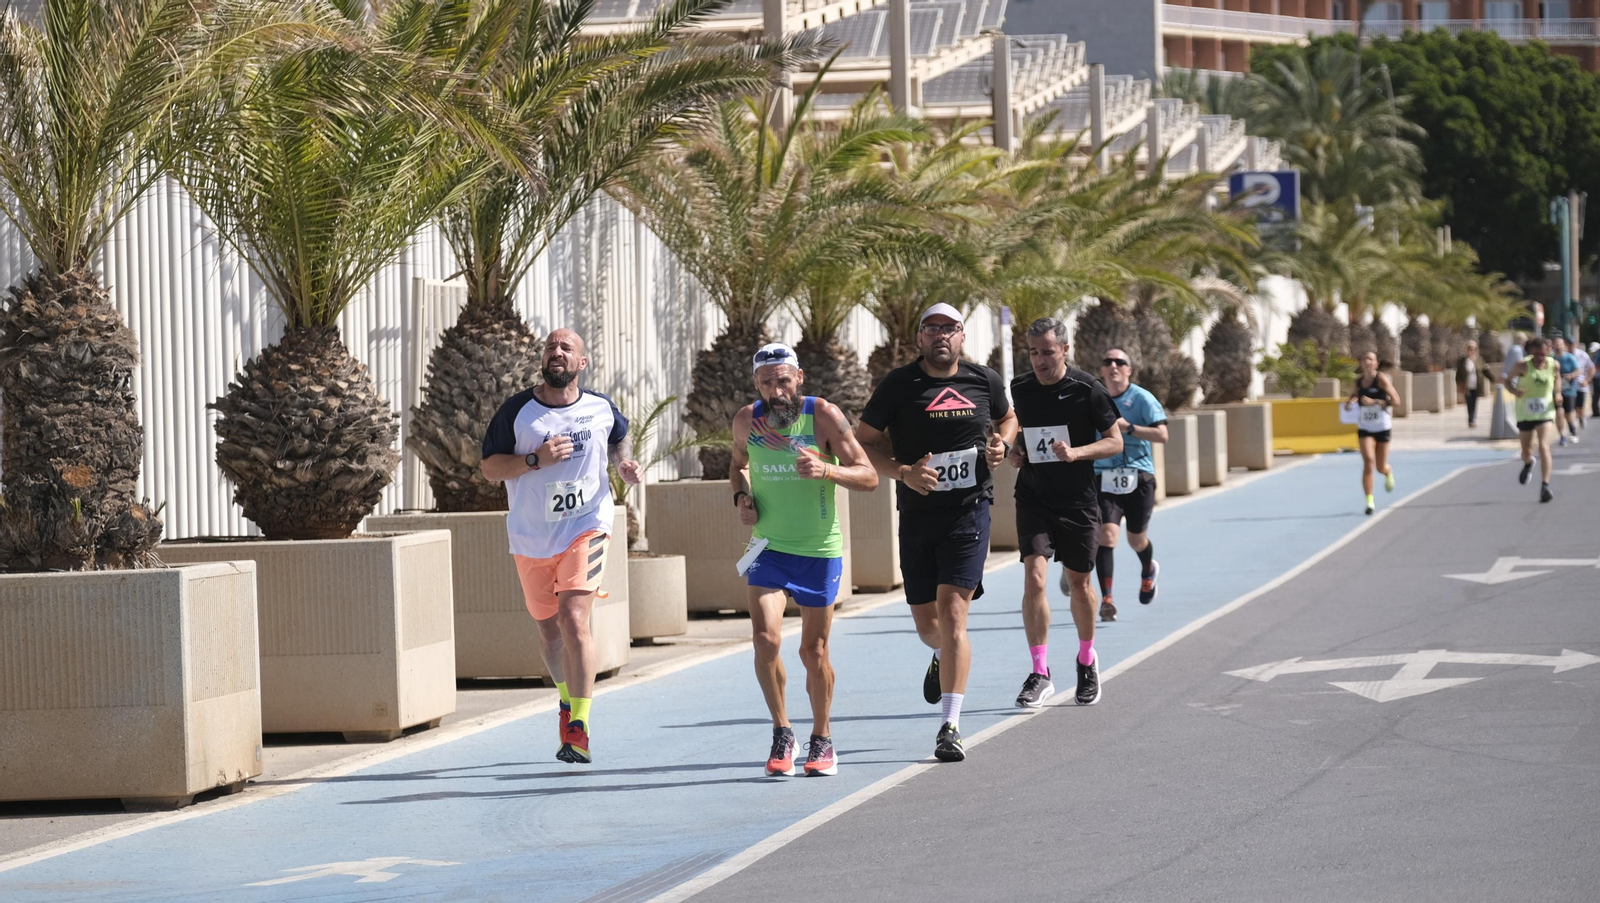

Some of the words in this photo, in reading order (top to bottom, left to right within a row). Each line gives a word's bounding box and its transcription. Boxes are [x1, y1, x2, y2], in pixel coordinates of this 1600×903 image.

[951, 409, 974, 417] TRAIL
[569, 427, 592, 442] Cortijo
[762, 463, 798, 473] SAKA
[934, 461, 969, 483] 208
[1112, 476, 1128, 488] 18
[552, 489, 585, 512] 201
